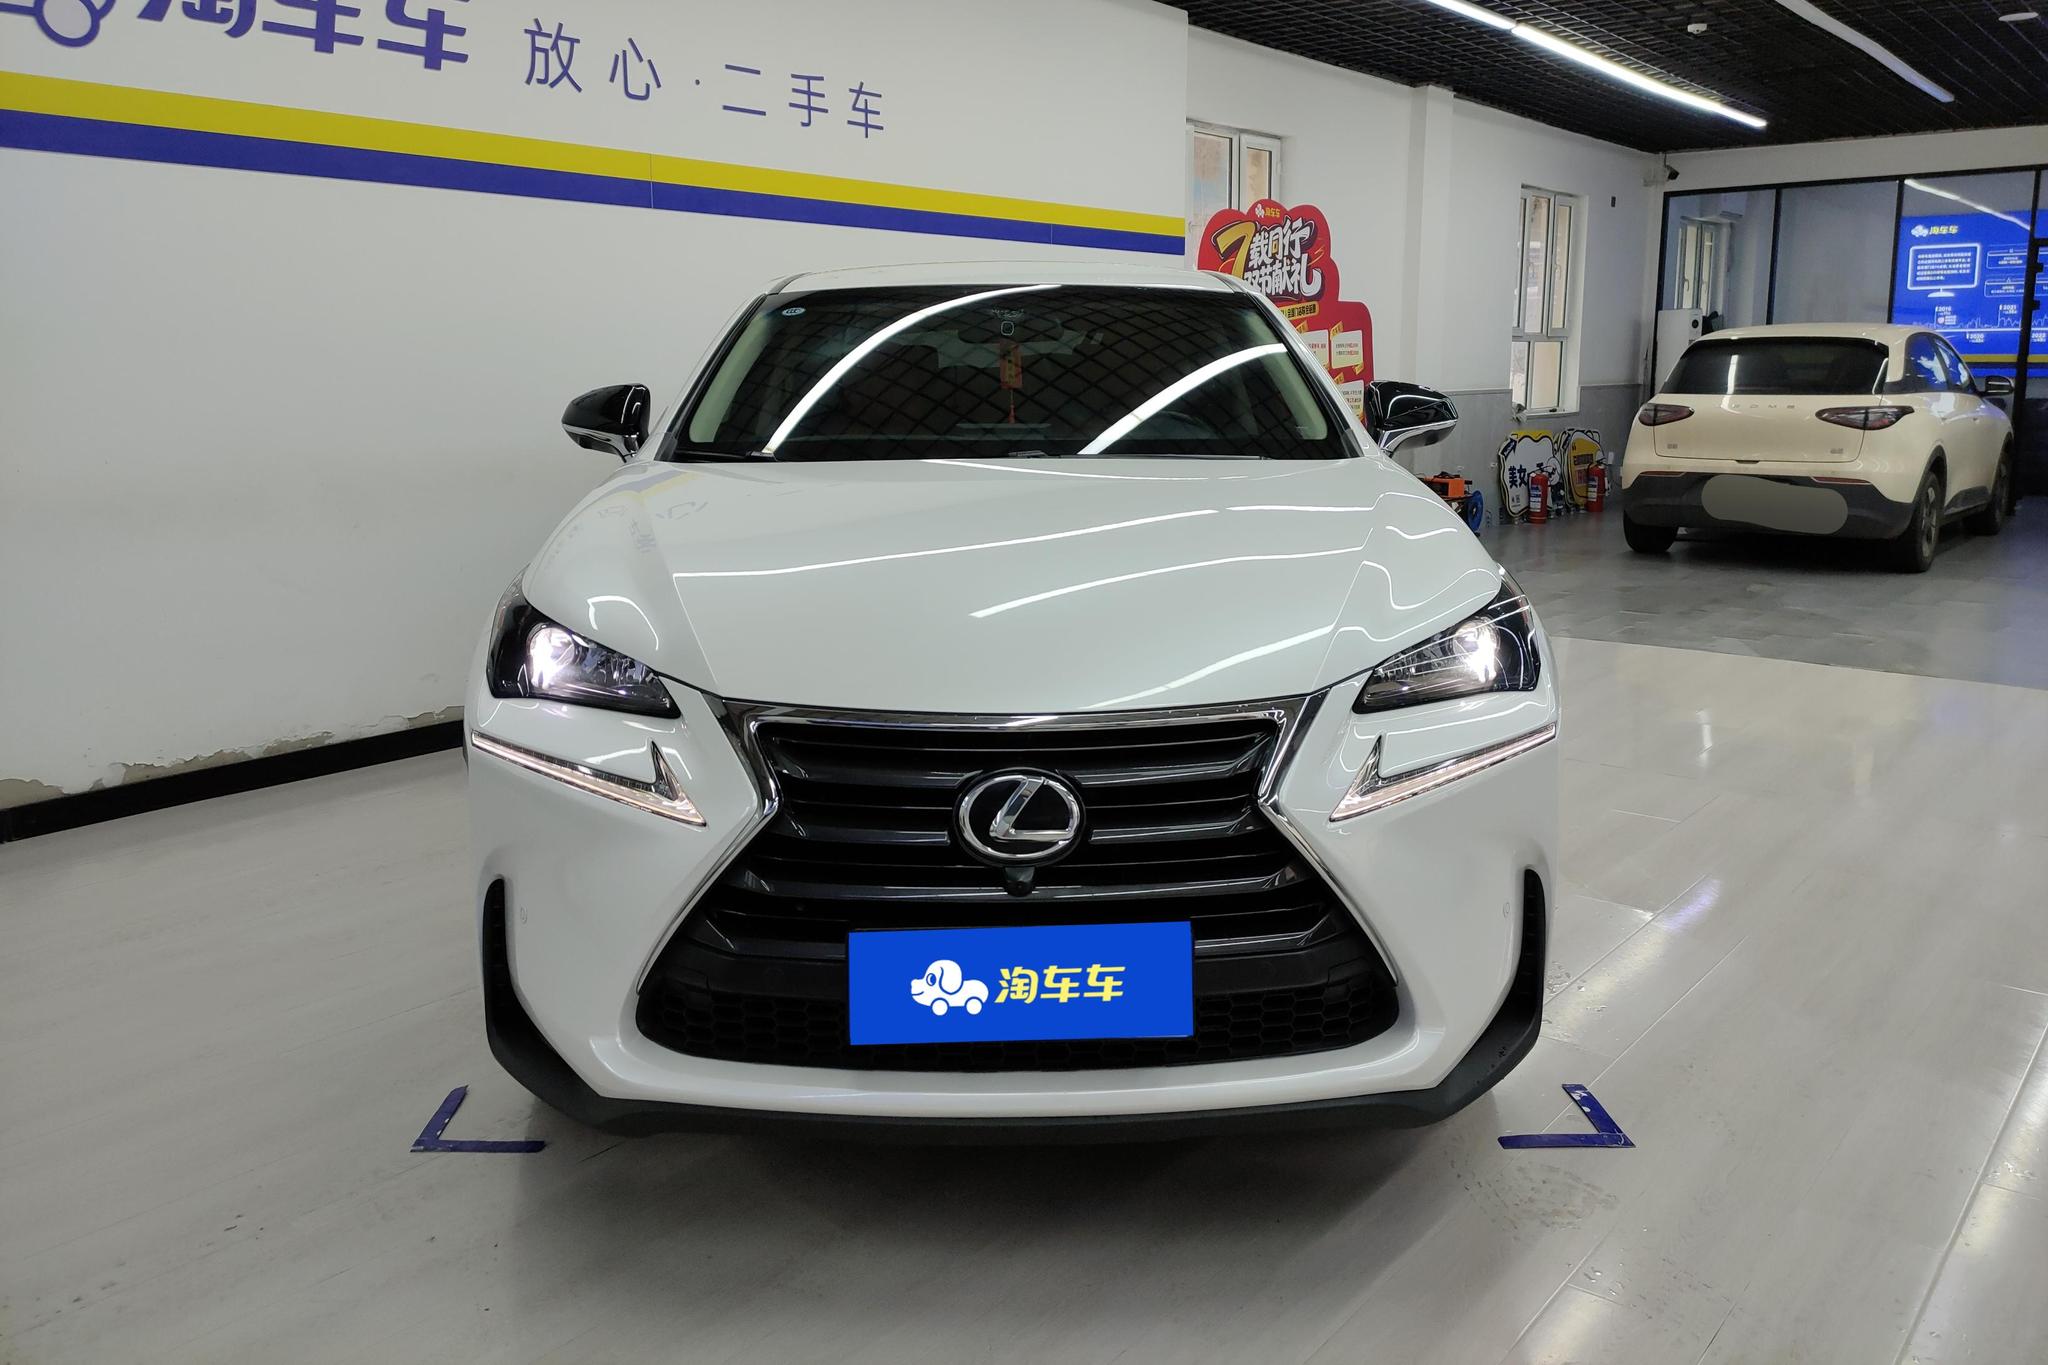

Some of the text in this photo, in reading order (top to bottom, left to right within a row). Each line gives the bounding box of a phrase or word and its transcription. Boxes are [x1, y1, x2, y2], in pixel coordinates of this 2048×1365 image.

[524, 18, 884, 138] 放心·二手车
